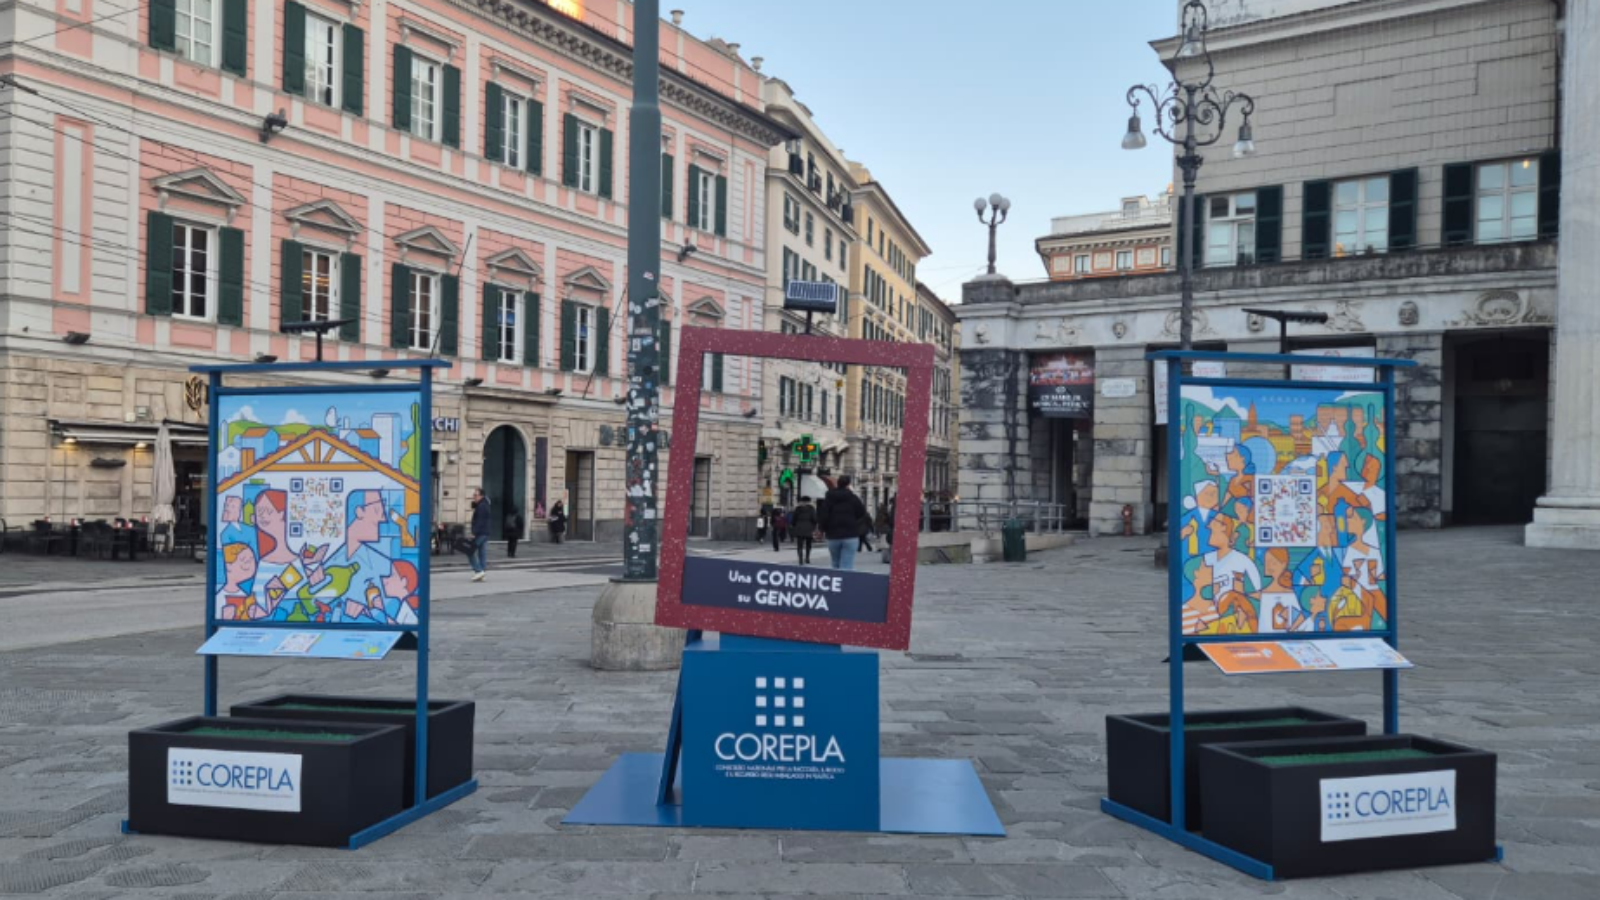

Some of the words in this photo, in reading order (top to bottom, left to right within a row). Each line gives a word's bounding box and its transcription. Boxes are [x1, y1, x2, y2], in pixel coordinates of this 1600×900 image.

[431, 417, 460, 431] CHI
[728, 569, 752, 584] Una
[756, 569, 843, 592] CORNICE
[737, 593, 751, 603] su
[755, 589, 829, 611] GENOVA
[714, 732, 845, 762] COREPLA
[196, 763, 294, 791] COREPLA
[1355, 786, 1450, 817] COREPLA
